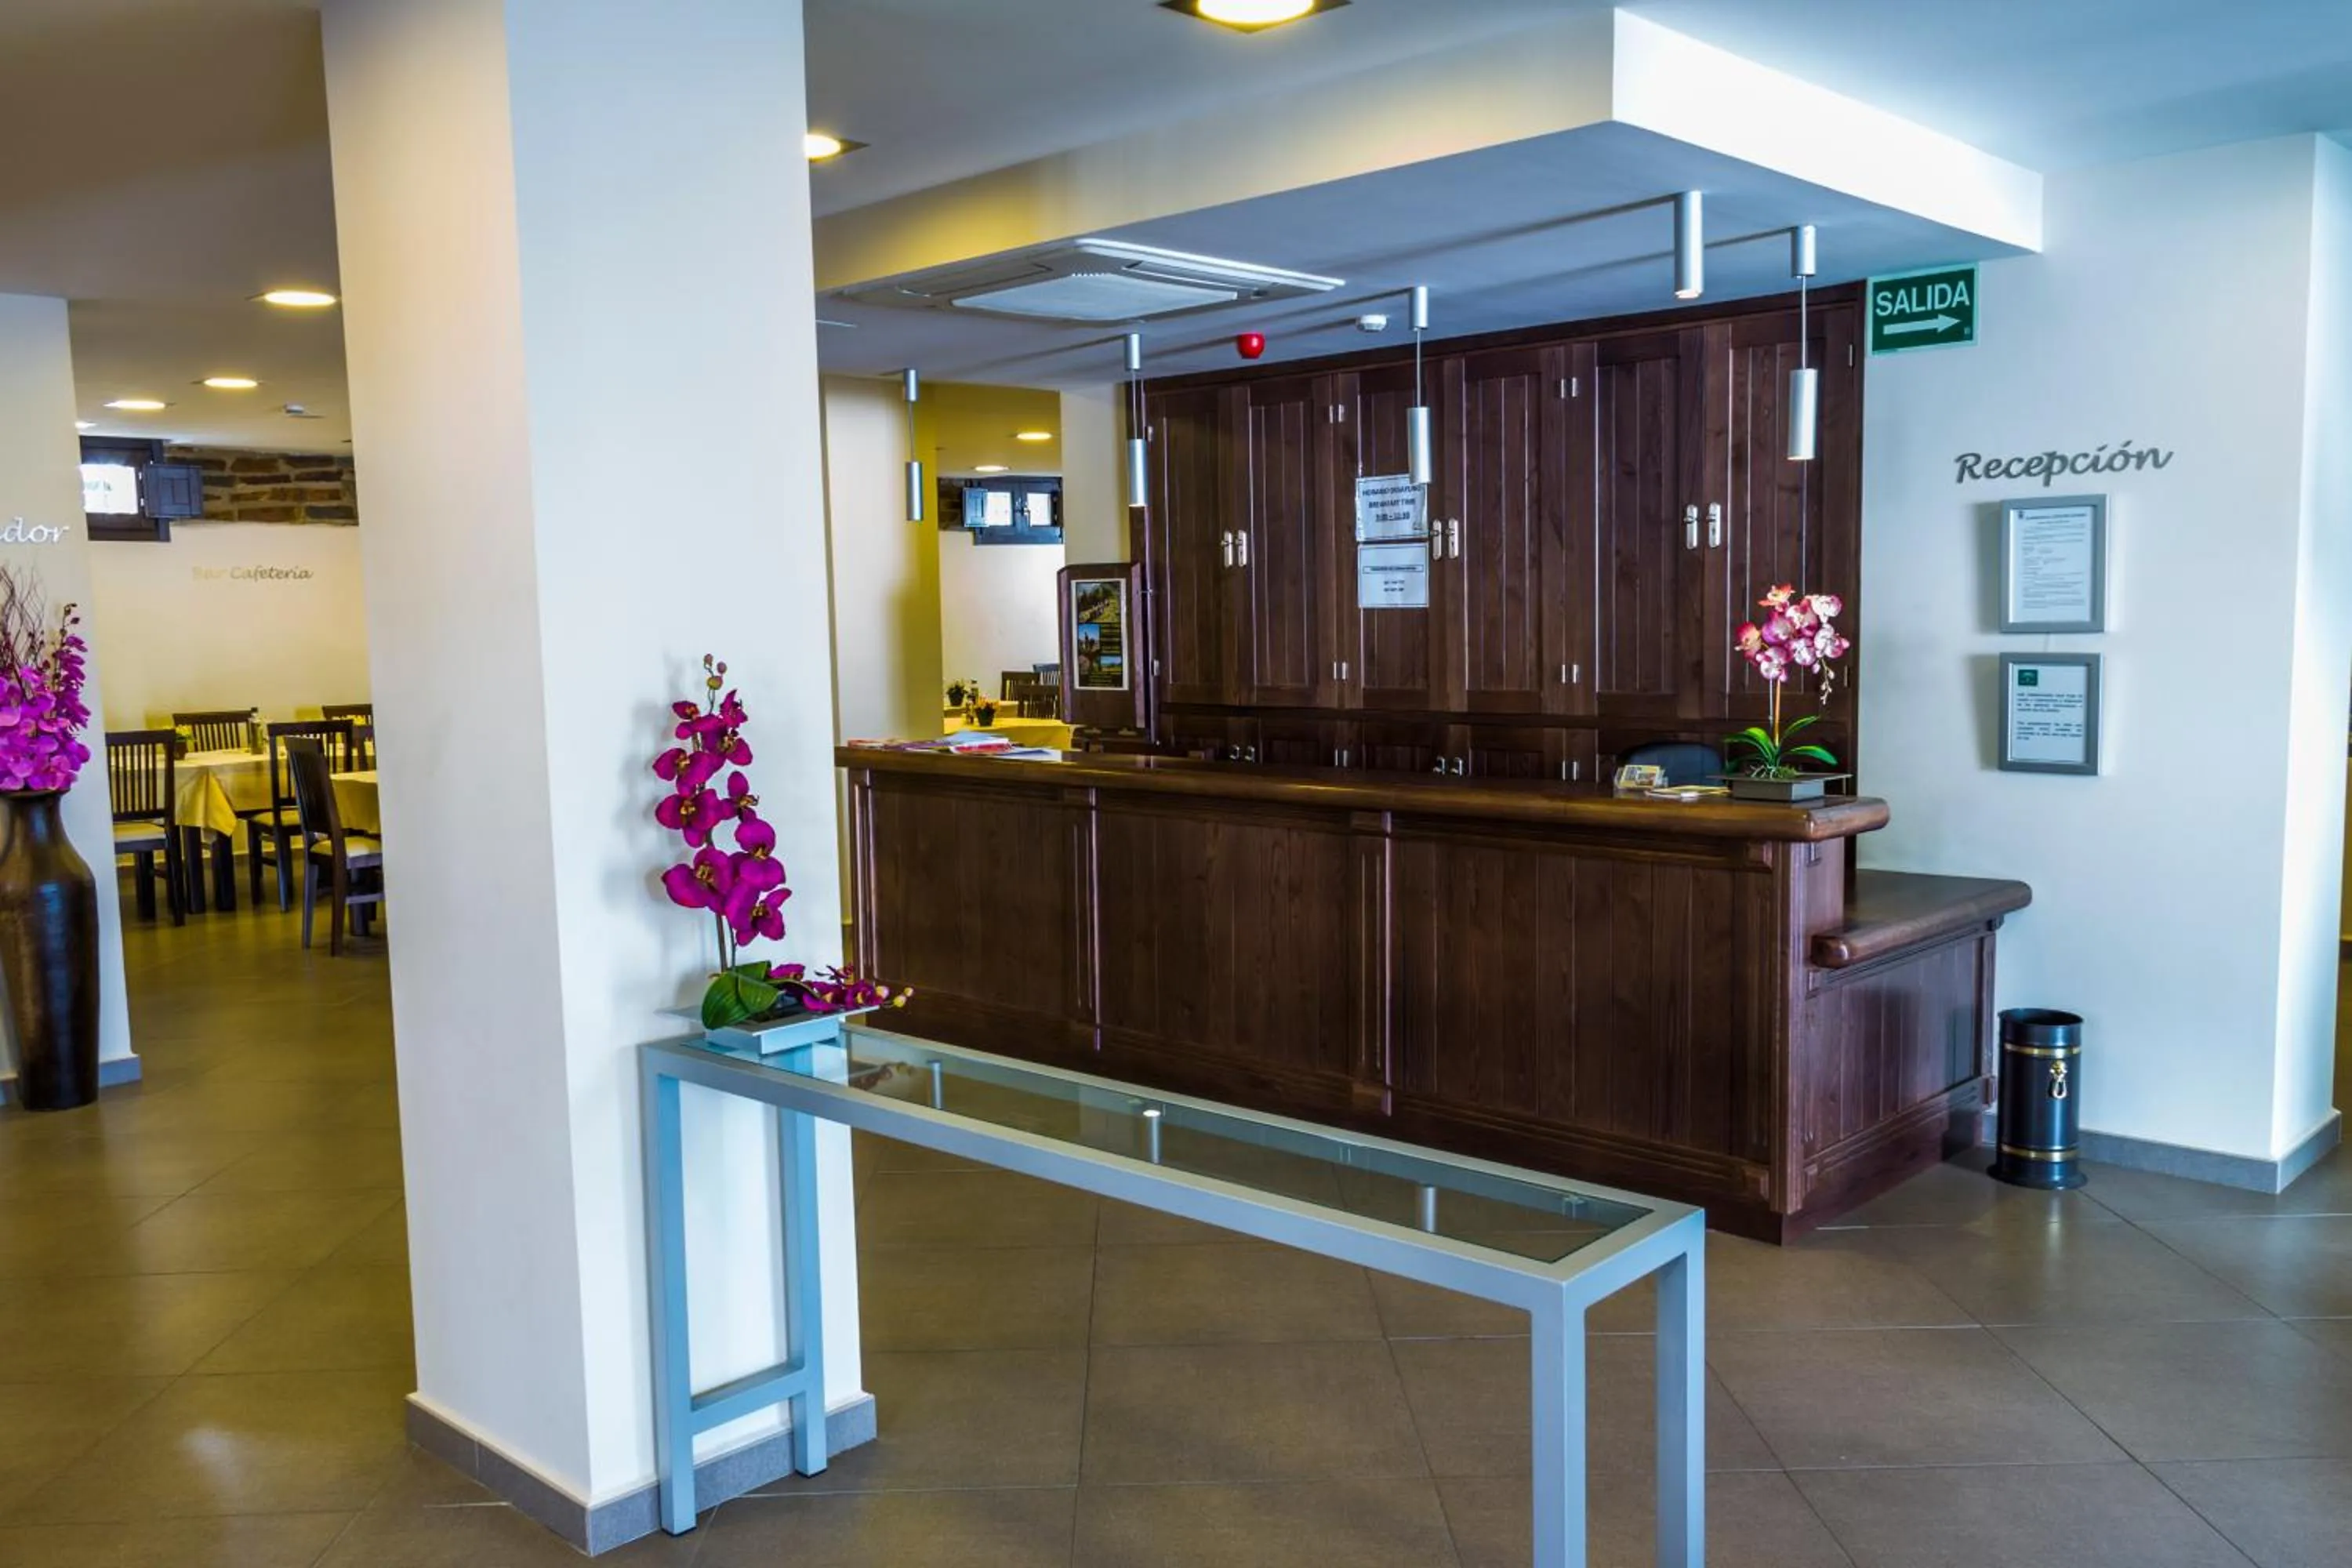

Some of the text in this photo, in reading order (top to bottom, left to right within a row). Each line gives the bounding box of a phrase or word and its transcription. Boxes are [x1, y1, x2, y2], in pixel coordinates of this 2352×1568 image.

[1875, 280, 1970, 317] SALIDA
[1954, 440, 2174, 488] Recepción
[0, 516, 70, 543] dor
